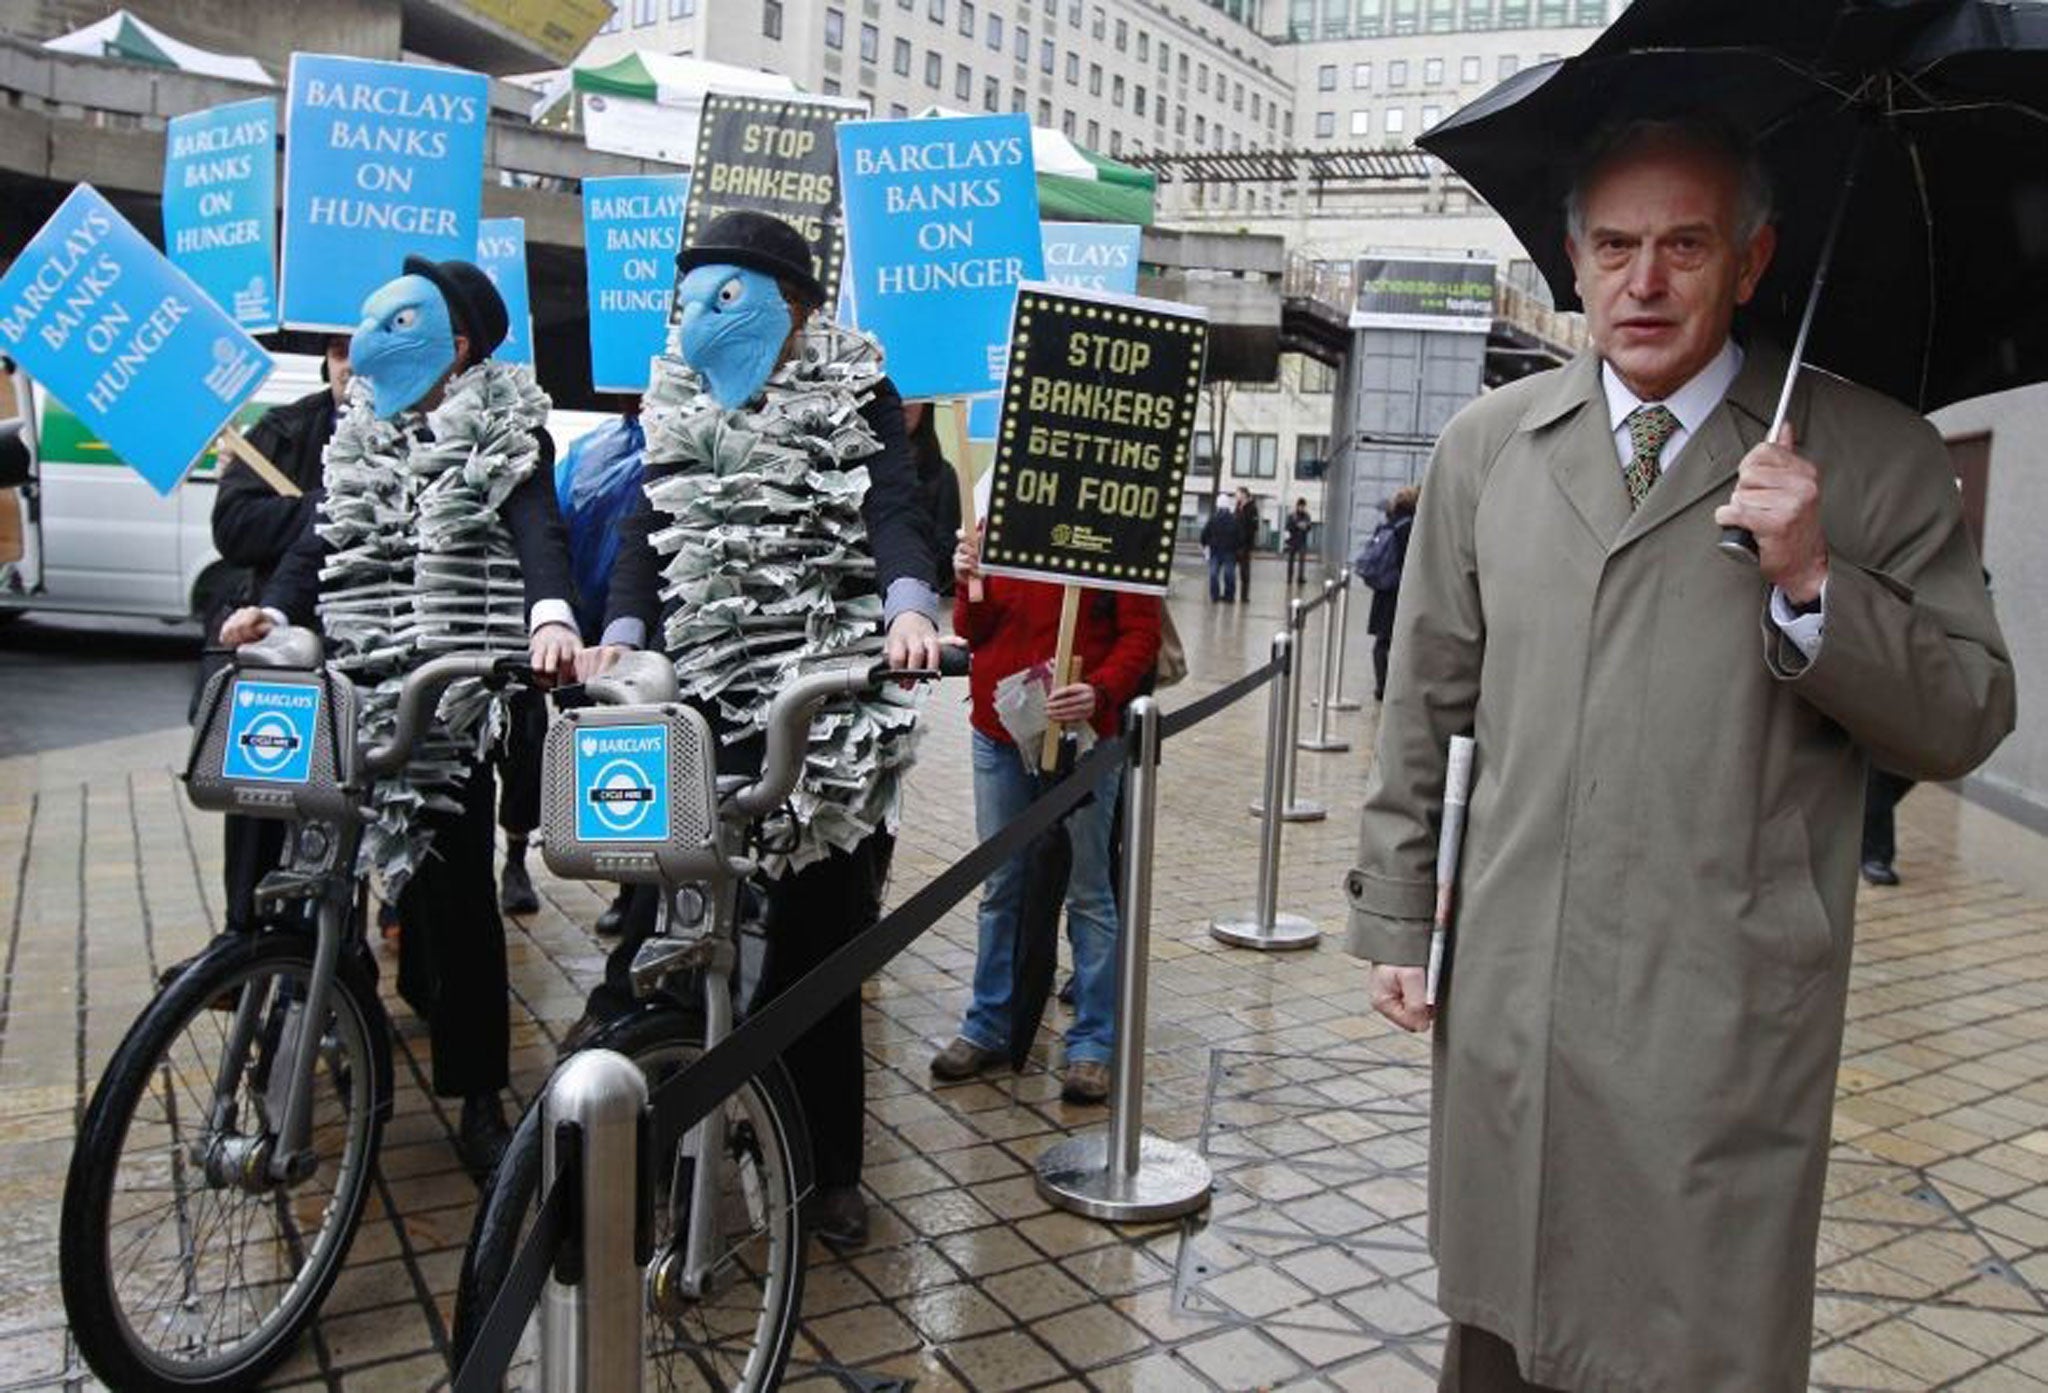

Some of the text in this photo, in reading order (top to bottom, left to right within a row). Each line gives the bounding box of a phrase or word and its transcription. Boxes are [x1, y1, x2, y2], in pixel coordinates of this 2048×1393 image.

[306, 80, 477, 124] BARCLAYS
[173, 119, 268, 159] BARCLAYS
[330, 121, 447, 159] BANKS
[742, 124, 815, 158] STOP
[855, 138, 1023, 175] BARCLAYS
[184, 155, 252, 188] BANKS
[357, 163, 413, 193] ON
[710, 164, 833, 204] BANKERS
[199, 191, 233, 217] ON
[886, 179, 1001, 214] BANKS
[310, 197, 459, 237] HUNGER
[918, 220, 974, 251] ON
[177, 219, 261, 254] HUNGER
[607, 227, 675, 251] BANKS
[1047, 242, 1130, 268] CLAYS
[0, 208, 112, 343] BARCLAYS
[624, 258, 658, 281] ON
[878, 257, 1024, 295] HUNGER
[41, 253, 121, 350] BANKS
[600, 289, 673, 312] HUNGE
[87, 301, 131, 354] ON
[87, 296, 189, 414] HUNGER
[1067, 332, 1151, 375] STOP
[1028, 376, 1174, 429] BANKERS
[1027, 426, 1161, 471] BETTING
[1016, 469, 1159, 519] ON FOOD
[255, 692, 313, 709] BARCLAYS
[598, 736, 662, 754] BARCLAYS
